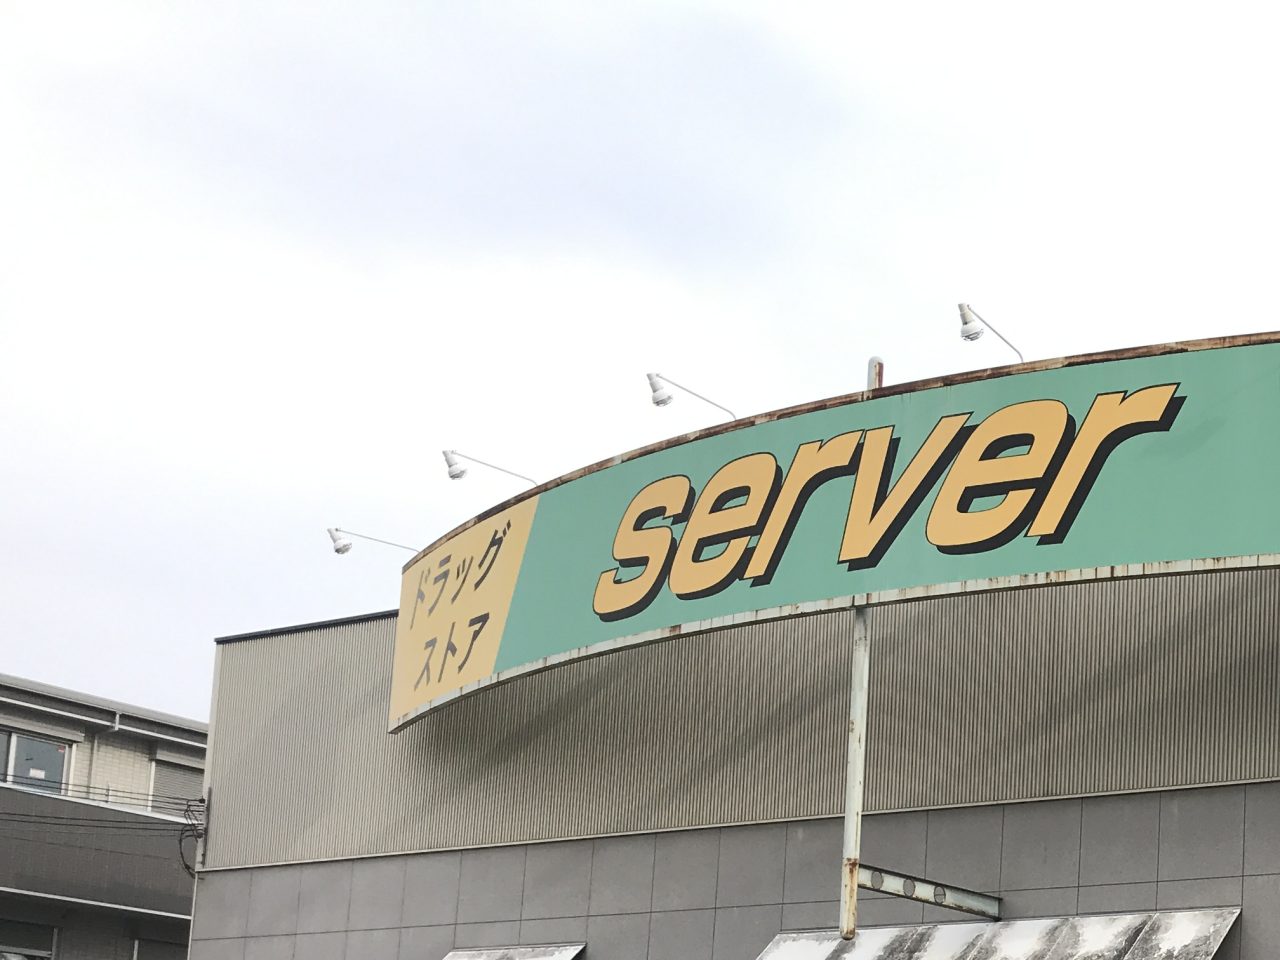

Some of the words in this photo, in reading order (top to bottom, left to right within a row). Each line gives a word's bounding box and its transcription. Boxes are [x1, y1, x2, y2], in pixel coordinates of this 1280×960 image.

[592, 383, 1186, 622] server
[410, 519, 512, 631] ドラッグ
[414, 612, 491, 692] ストア
